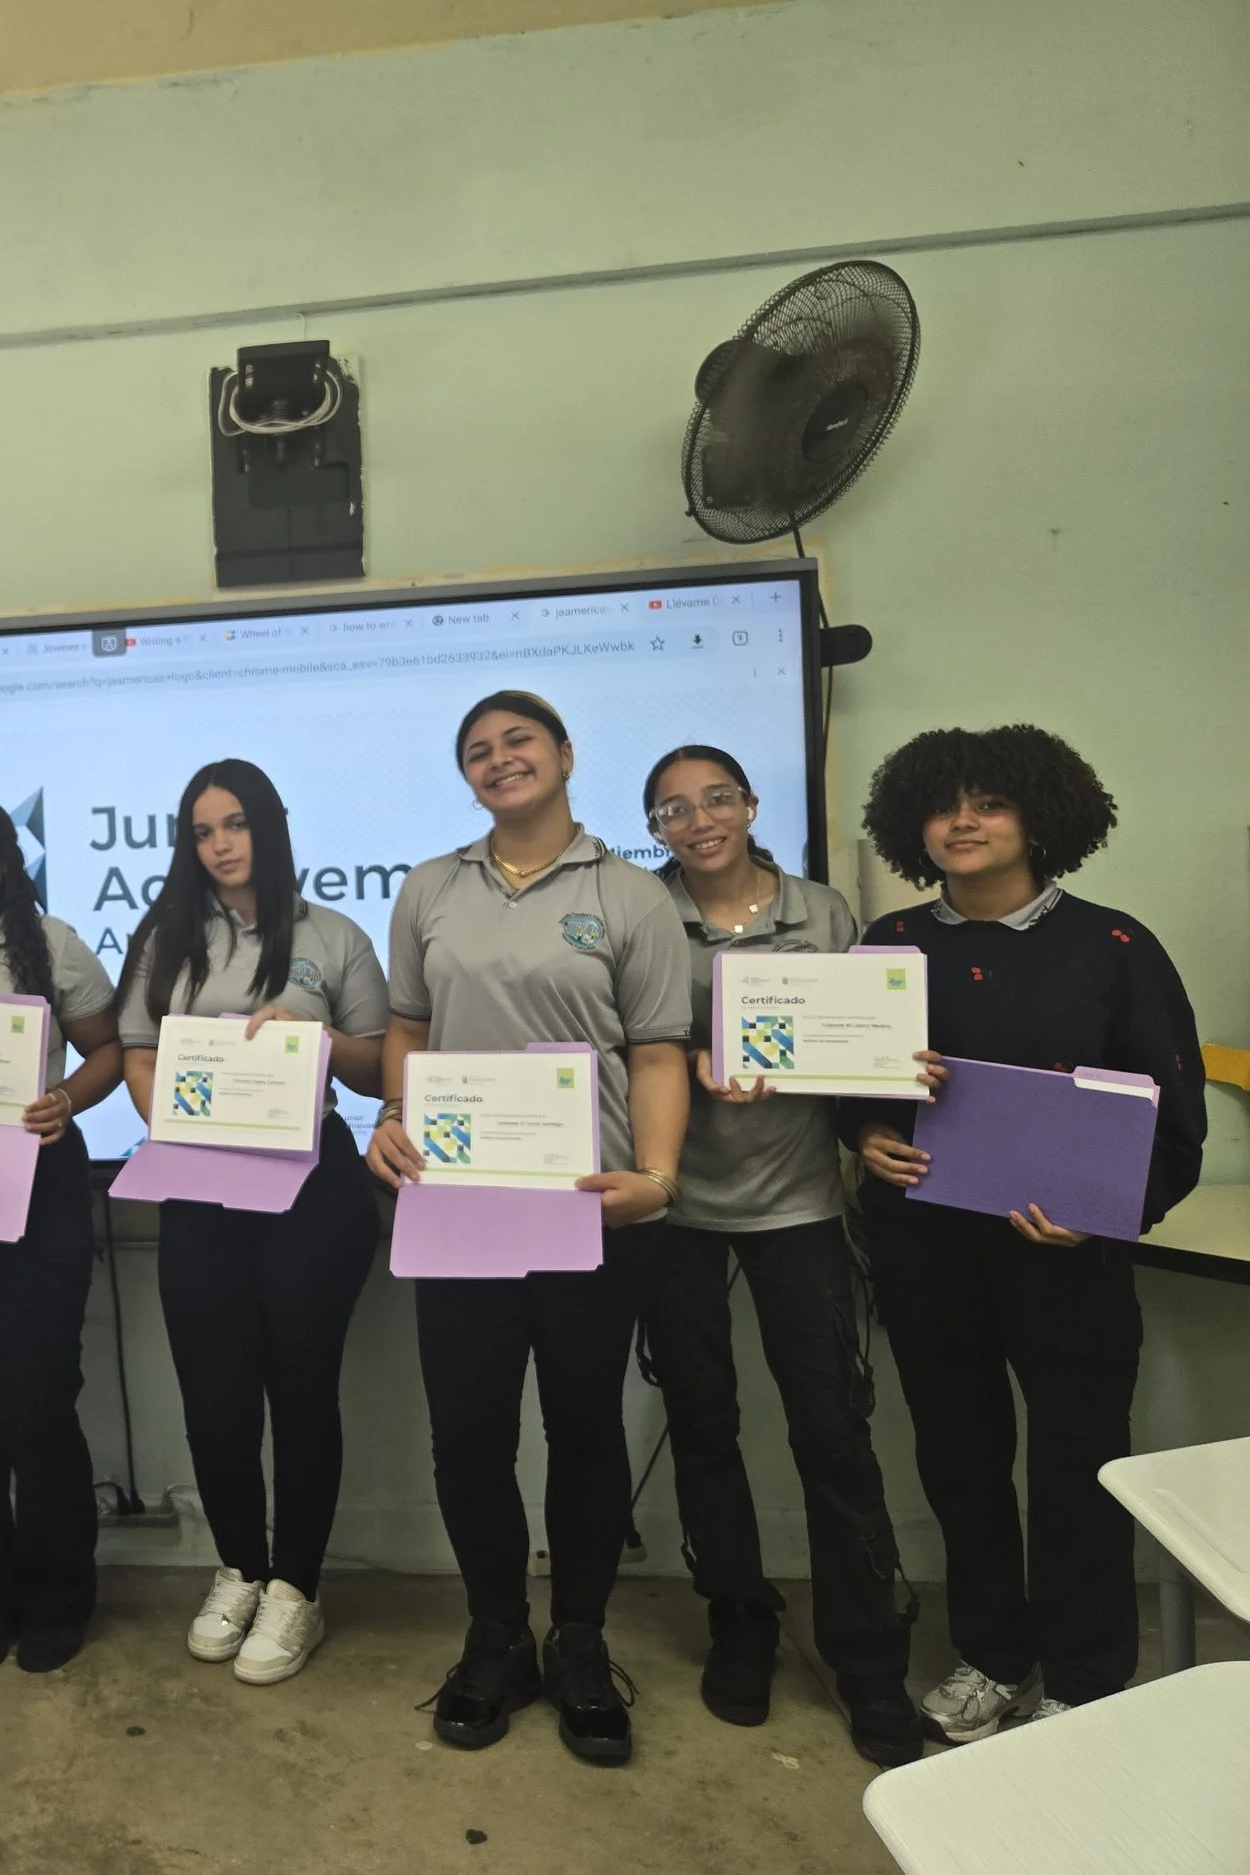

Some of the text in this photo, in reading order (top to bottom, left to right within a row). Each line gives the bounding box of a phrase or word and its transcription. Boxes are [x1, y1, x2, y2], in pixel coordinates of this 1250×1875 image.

[448, 612, 490, 625] New tab
[343, 621, 365, 632] how
[366, 621, 376, 632] to
[240, 627, 283, 640] Wheel of
[741, 996, 806, 1004] Certificado
[177, 1053, 225, 1063] Certificado
[424, 1094, 483, 1104] Certificado
